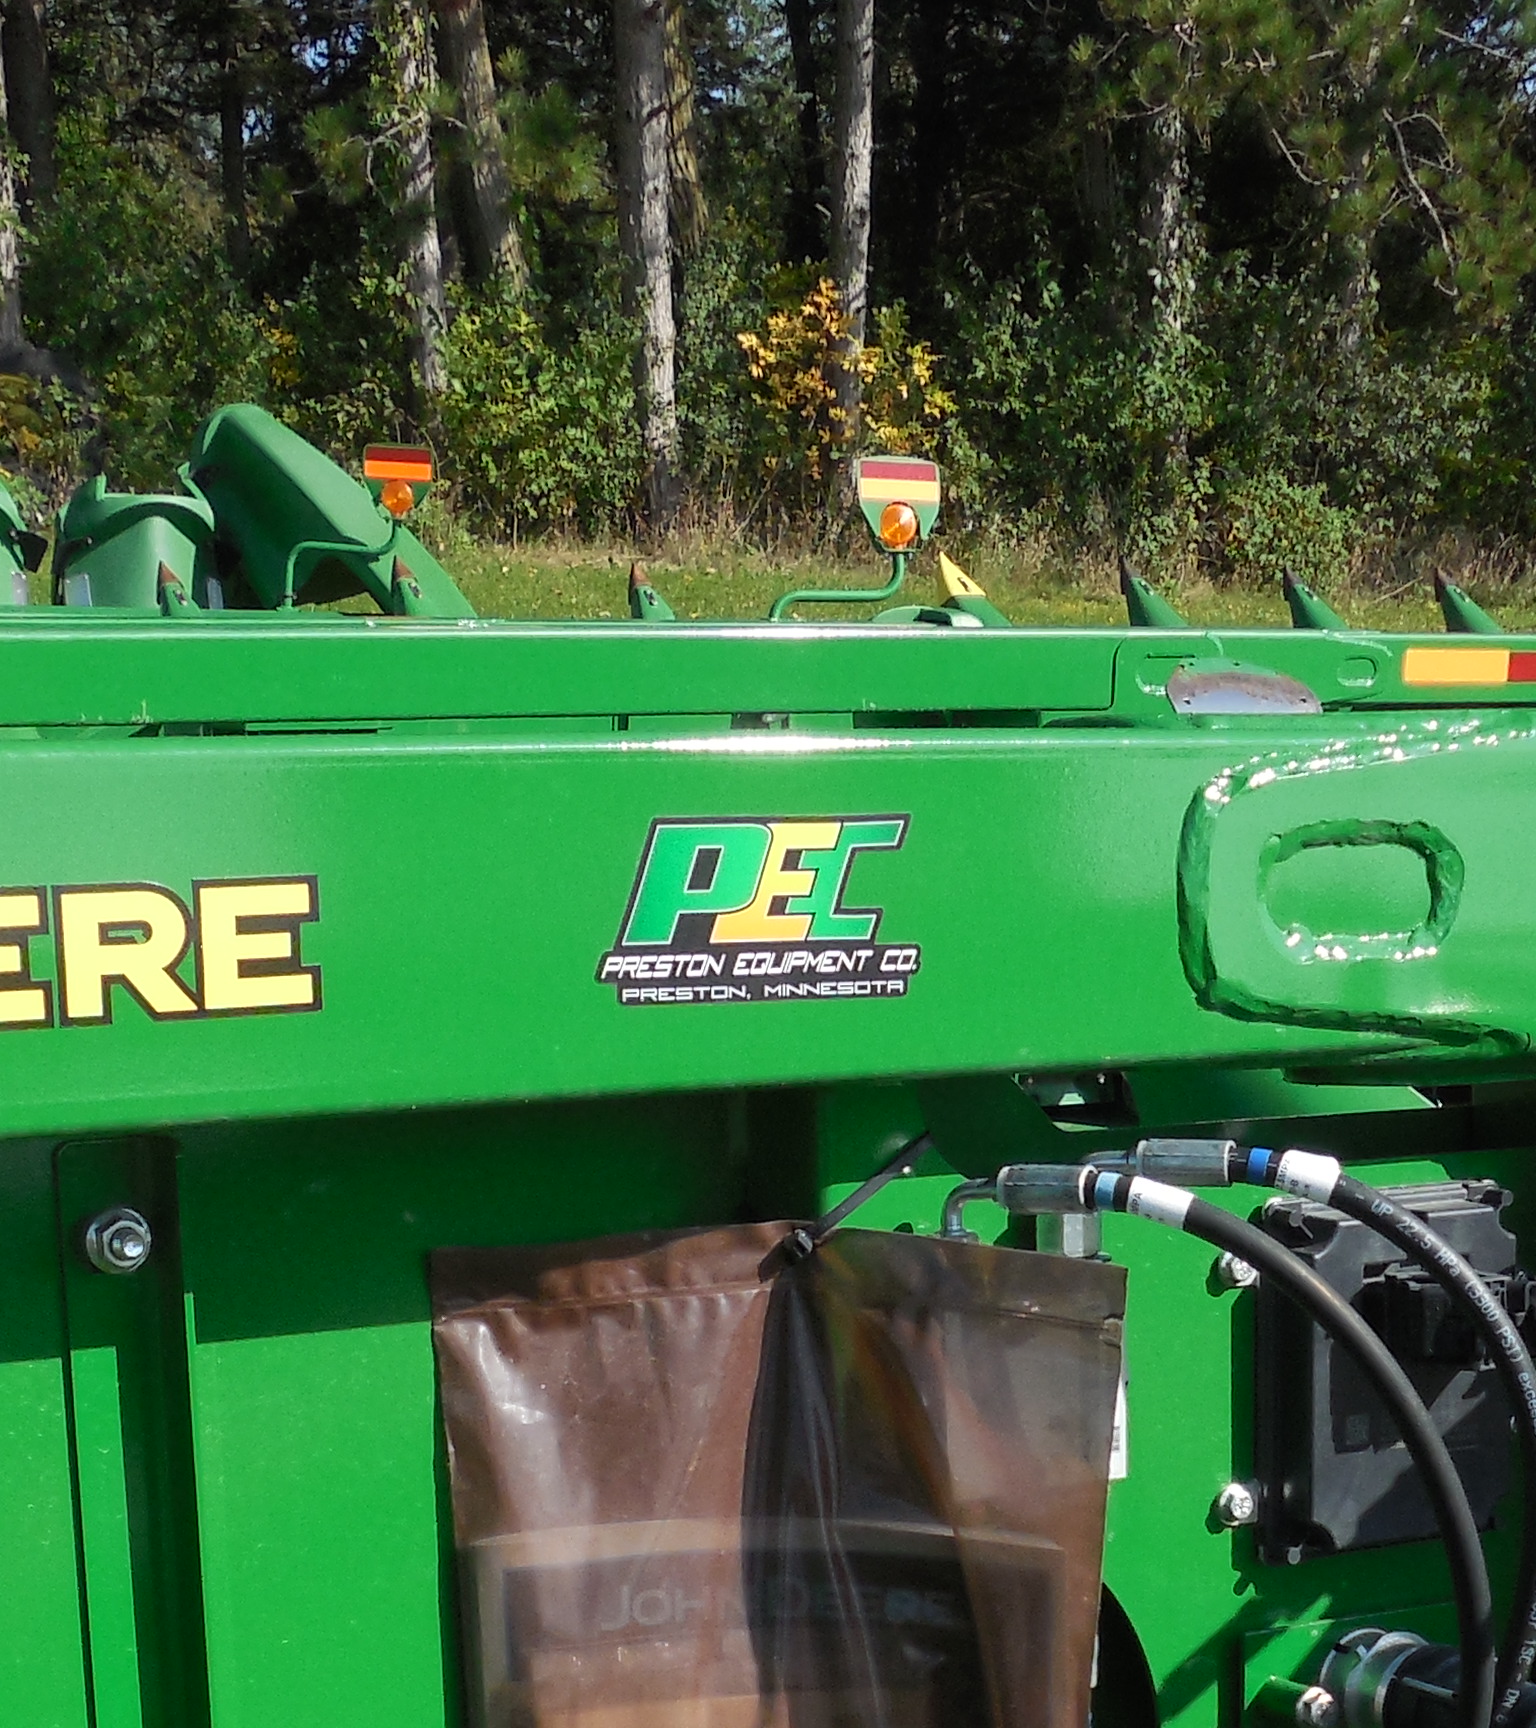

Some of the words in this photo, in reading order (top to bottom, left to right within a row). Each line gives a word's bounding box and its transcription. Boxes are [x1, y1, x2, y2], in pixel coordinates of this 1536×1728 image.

[620, 815, 906, 946] PEC
[600, 952, 726, 980] PRESTON
[732, 950, 875, 977] EQUIPMENT
[879, 948, 919, 972] CO.
[621, 984, 752, 1003] PRESTON,
[764, 979, 904, 998] MINNESOTA
[1501, 1688, 1521, 1710] DN
